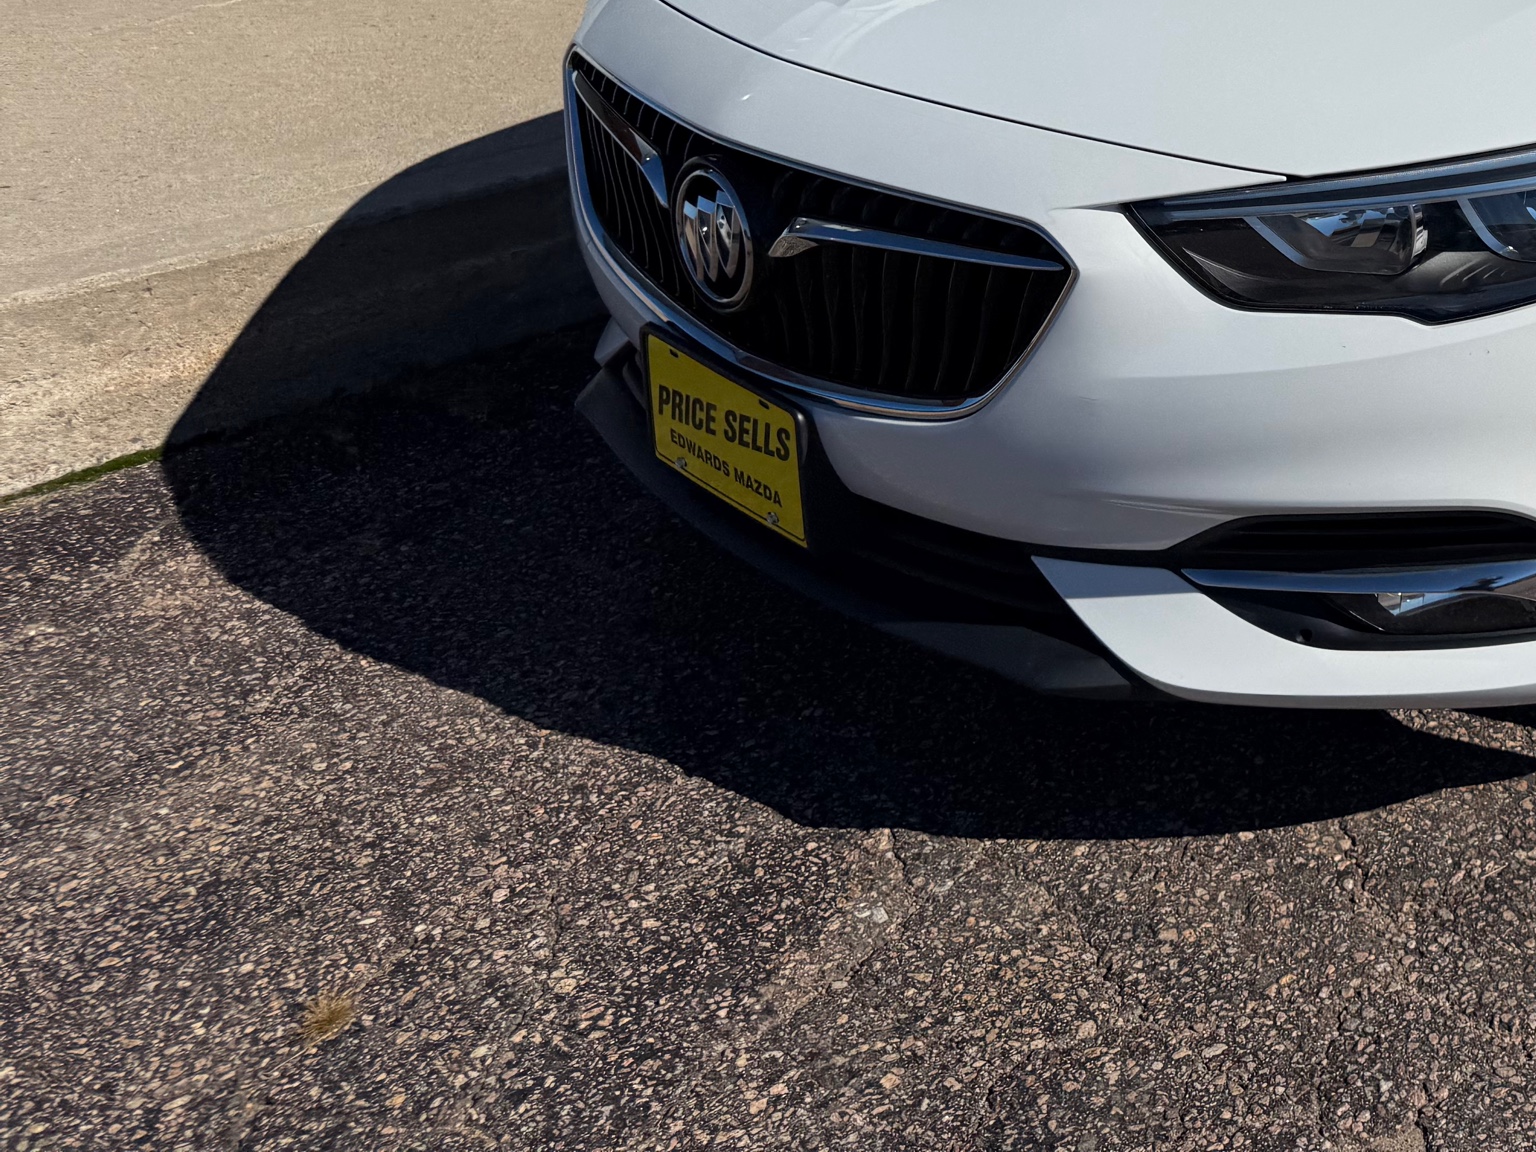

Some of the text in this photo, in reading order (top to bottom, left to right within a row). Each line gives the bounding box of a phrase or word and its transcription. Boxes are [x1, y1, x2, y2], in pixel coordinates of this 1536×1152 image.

[657, 383, 791, 462] PRICE SELLS
[669, 428, 783, 508] EDWARDS MAZDA
